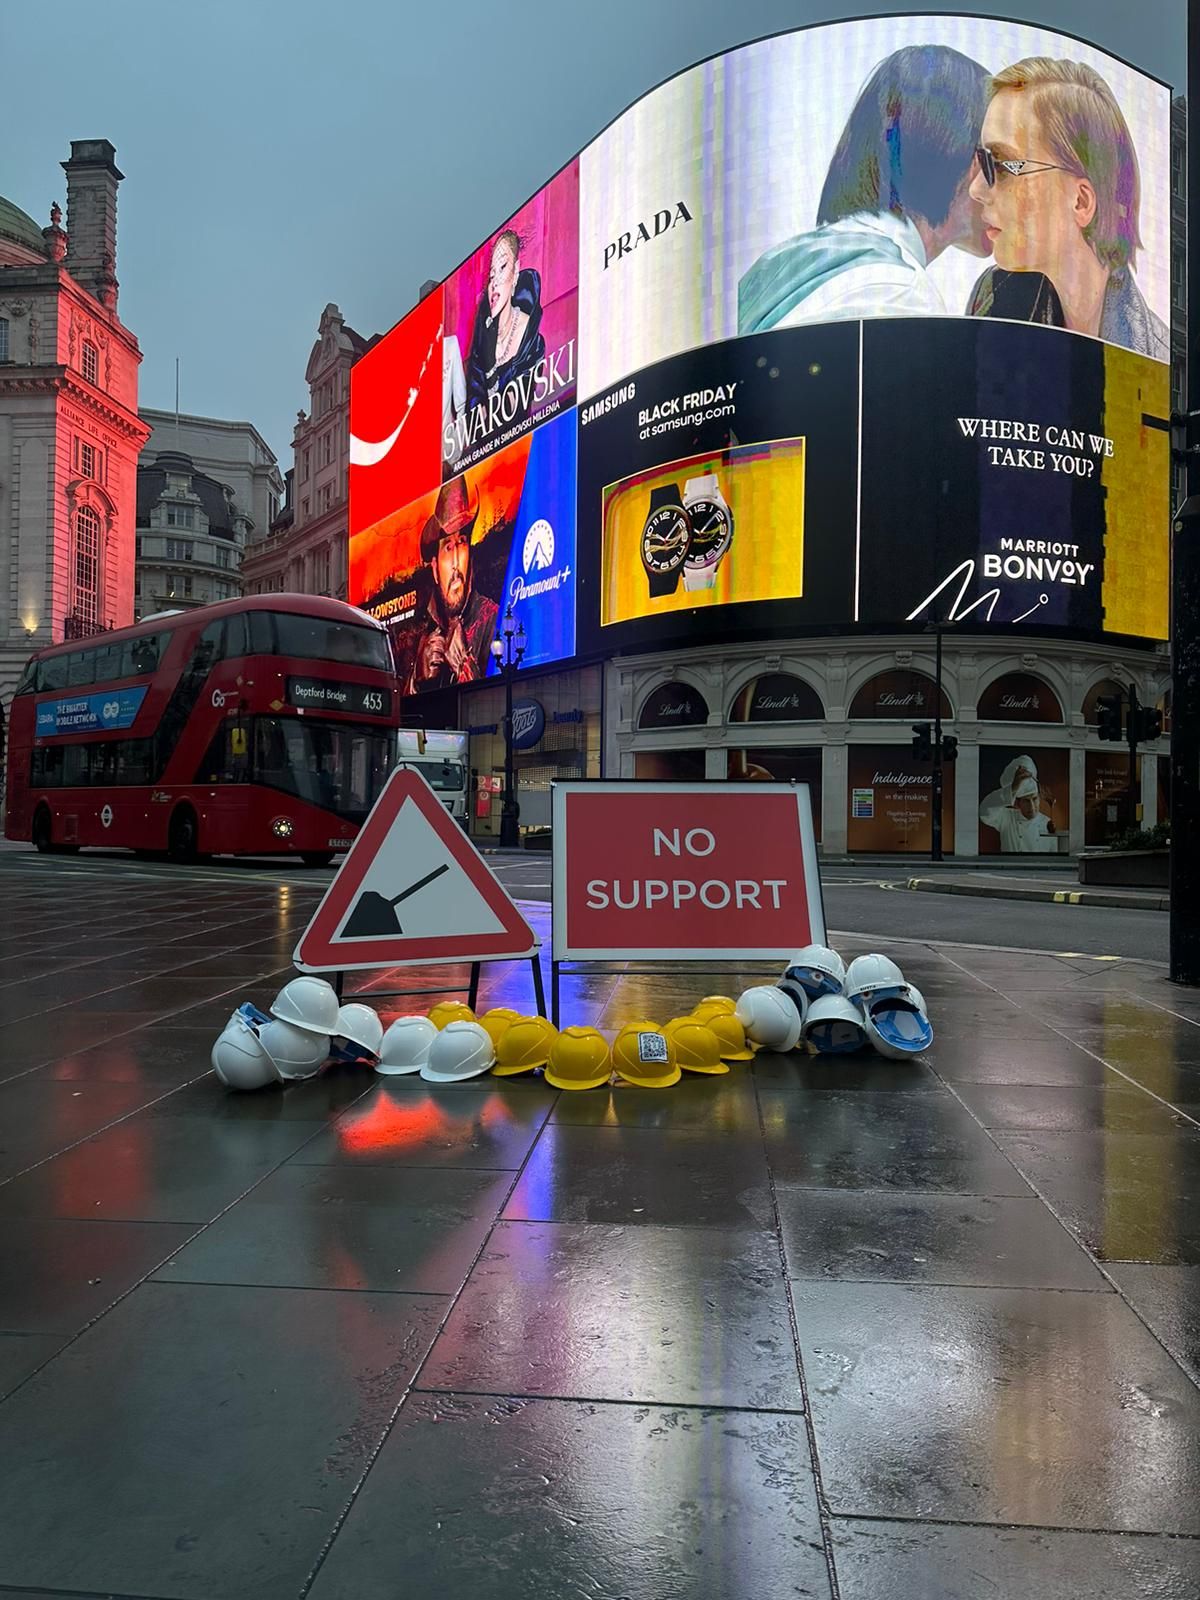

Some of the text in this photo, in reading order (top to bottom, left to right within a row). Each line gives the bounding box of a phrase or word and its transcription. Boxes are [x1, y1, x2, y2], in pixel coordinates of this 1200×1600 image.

[603, 201, 693, 271] PRADA
[444, 338, 575, 460] SWAROVSKI
[581, 382, 636, 425] SAMSUNG
[638, 383, 737, 426] BLACK FRIDAY
[453, 400, 560, 472] ARIANA GRANDE IN SWAROVSKI MILLENIA
[639, 404, 736, 440] at samsung.com
[957, 418, 1114, 457] WHERE CAN WE
[987, 446, 1094, 478] TAKE YOU?
[1001, 537, 1079, 557] MARRIOTT
[510, 565, 571, 607] Paramount+
[984, 554, 1091, 586] BONVOY
[295, 684, 382, 710] Deptford Bridge 453
[658, 703, 684, 716] Lindt
[754, 695, 790, 709] Lindt
[875, 692, 915, 706] Lindt
[998, 694, 1032, 708] Lindt
[512, 705, 536, 740] Boots
[872, 771, 933, 788] Indulgence
[904, 793, 928, 802] making
[653, 827, 716, 857] NO
[586, 879, 787, 910] SUPPORT
